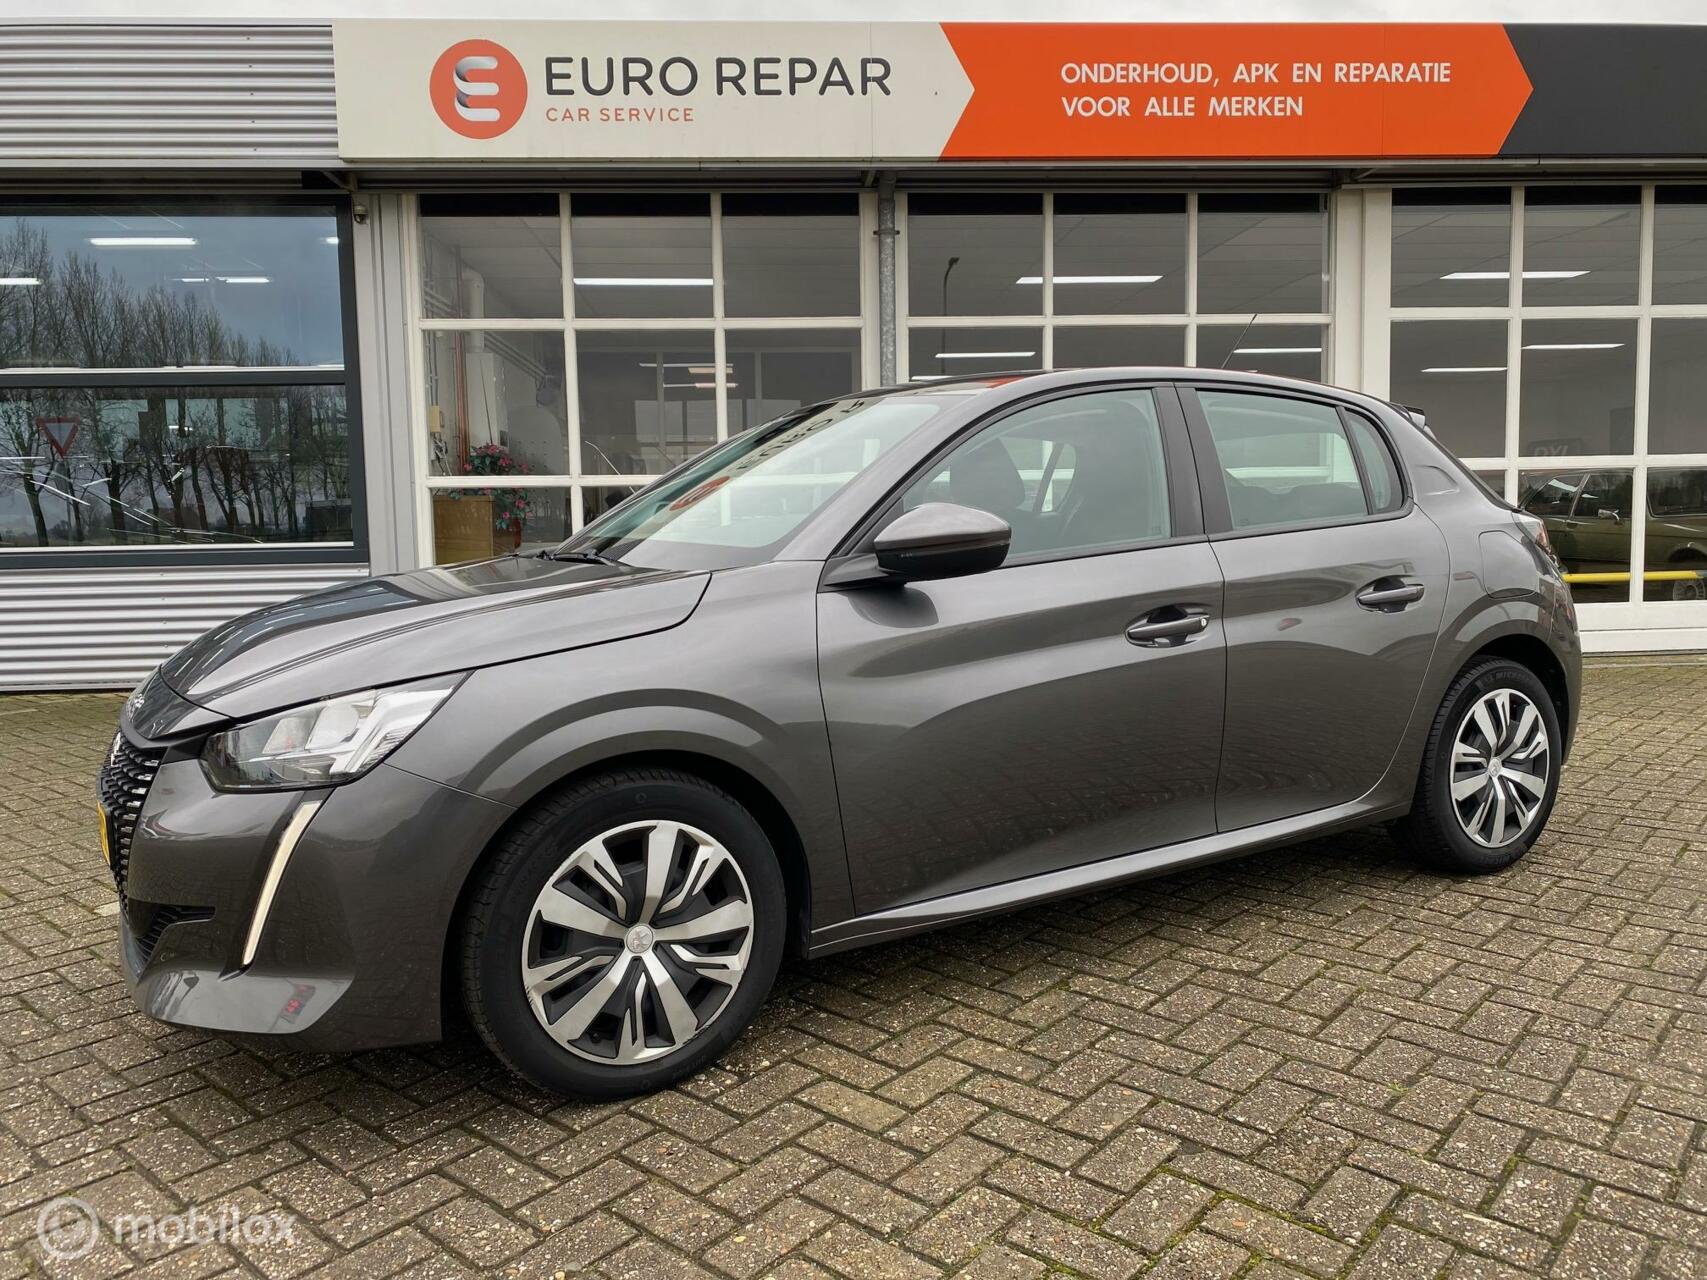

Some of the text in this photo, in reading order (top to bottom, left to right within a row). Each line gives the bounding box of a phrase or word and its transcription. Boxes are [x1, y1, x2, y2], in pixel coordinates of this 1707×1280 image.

[546, 56, 891, 97] EURO REPAR
[1061, 61, 1451, 87] ONDERHOUD, APK EN REPARATIE
[546, 107, 694, 122] CAR SERVICE
[1061, 96, 1303, 117] VOOR ALLE MERKEN
